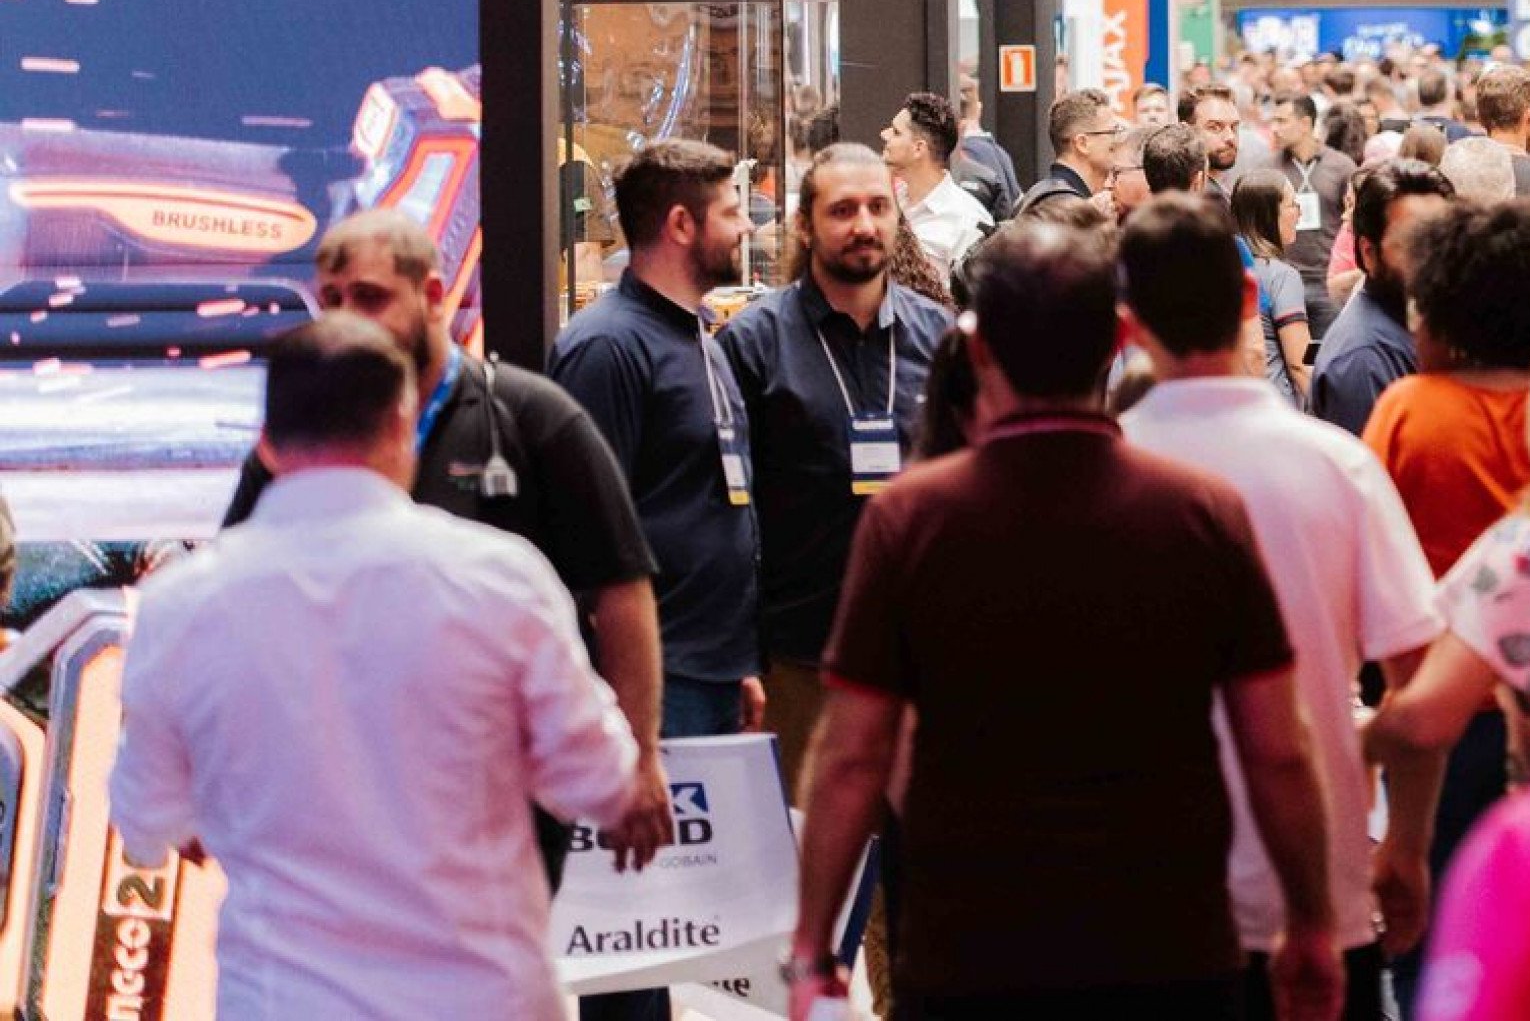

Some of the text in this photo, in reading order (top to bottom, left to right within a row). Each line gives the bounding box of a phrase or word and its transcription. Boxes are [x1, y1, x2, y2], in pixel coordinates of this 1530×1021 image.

[152, 210, 282, 239] BRUSHLESS
[116, 874, 162, 909] 2
[567, 917, 721, 955] Araldite
